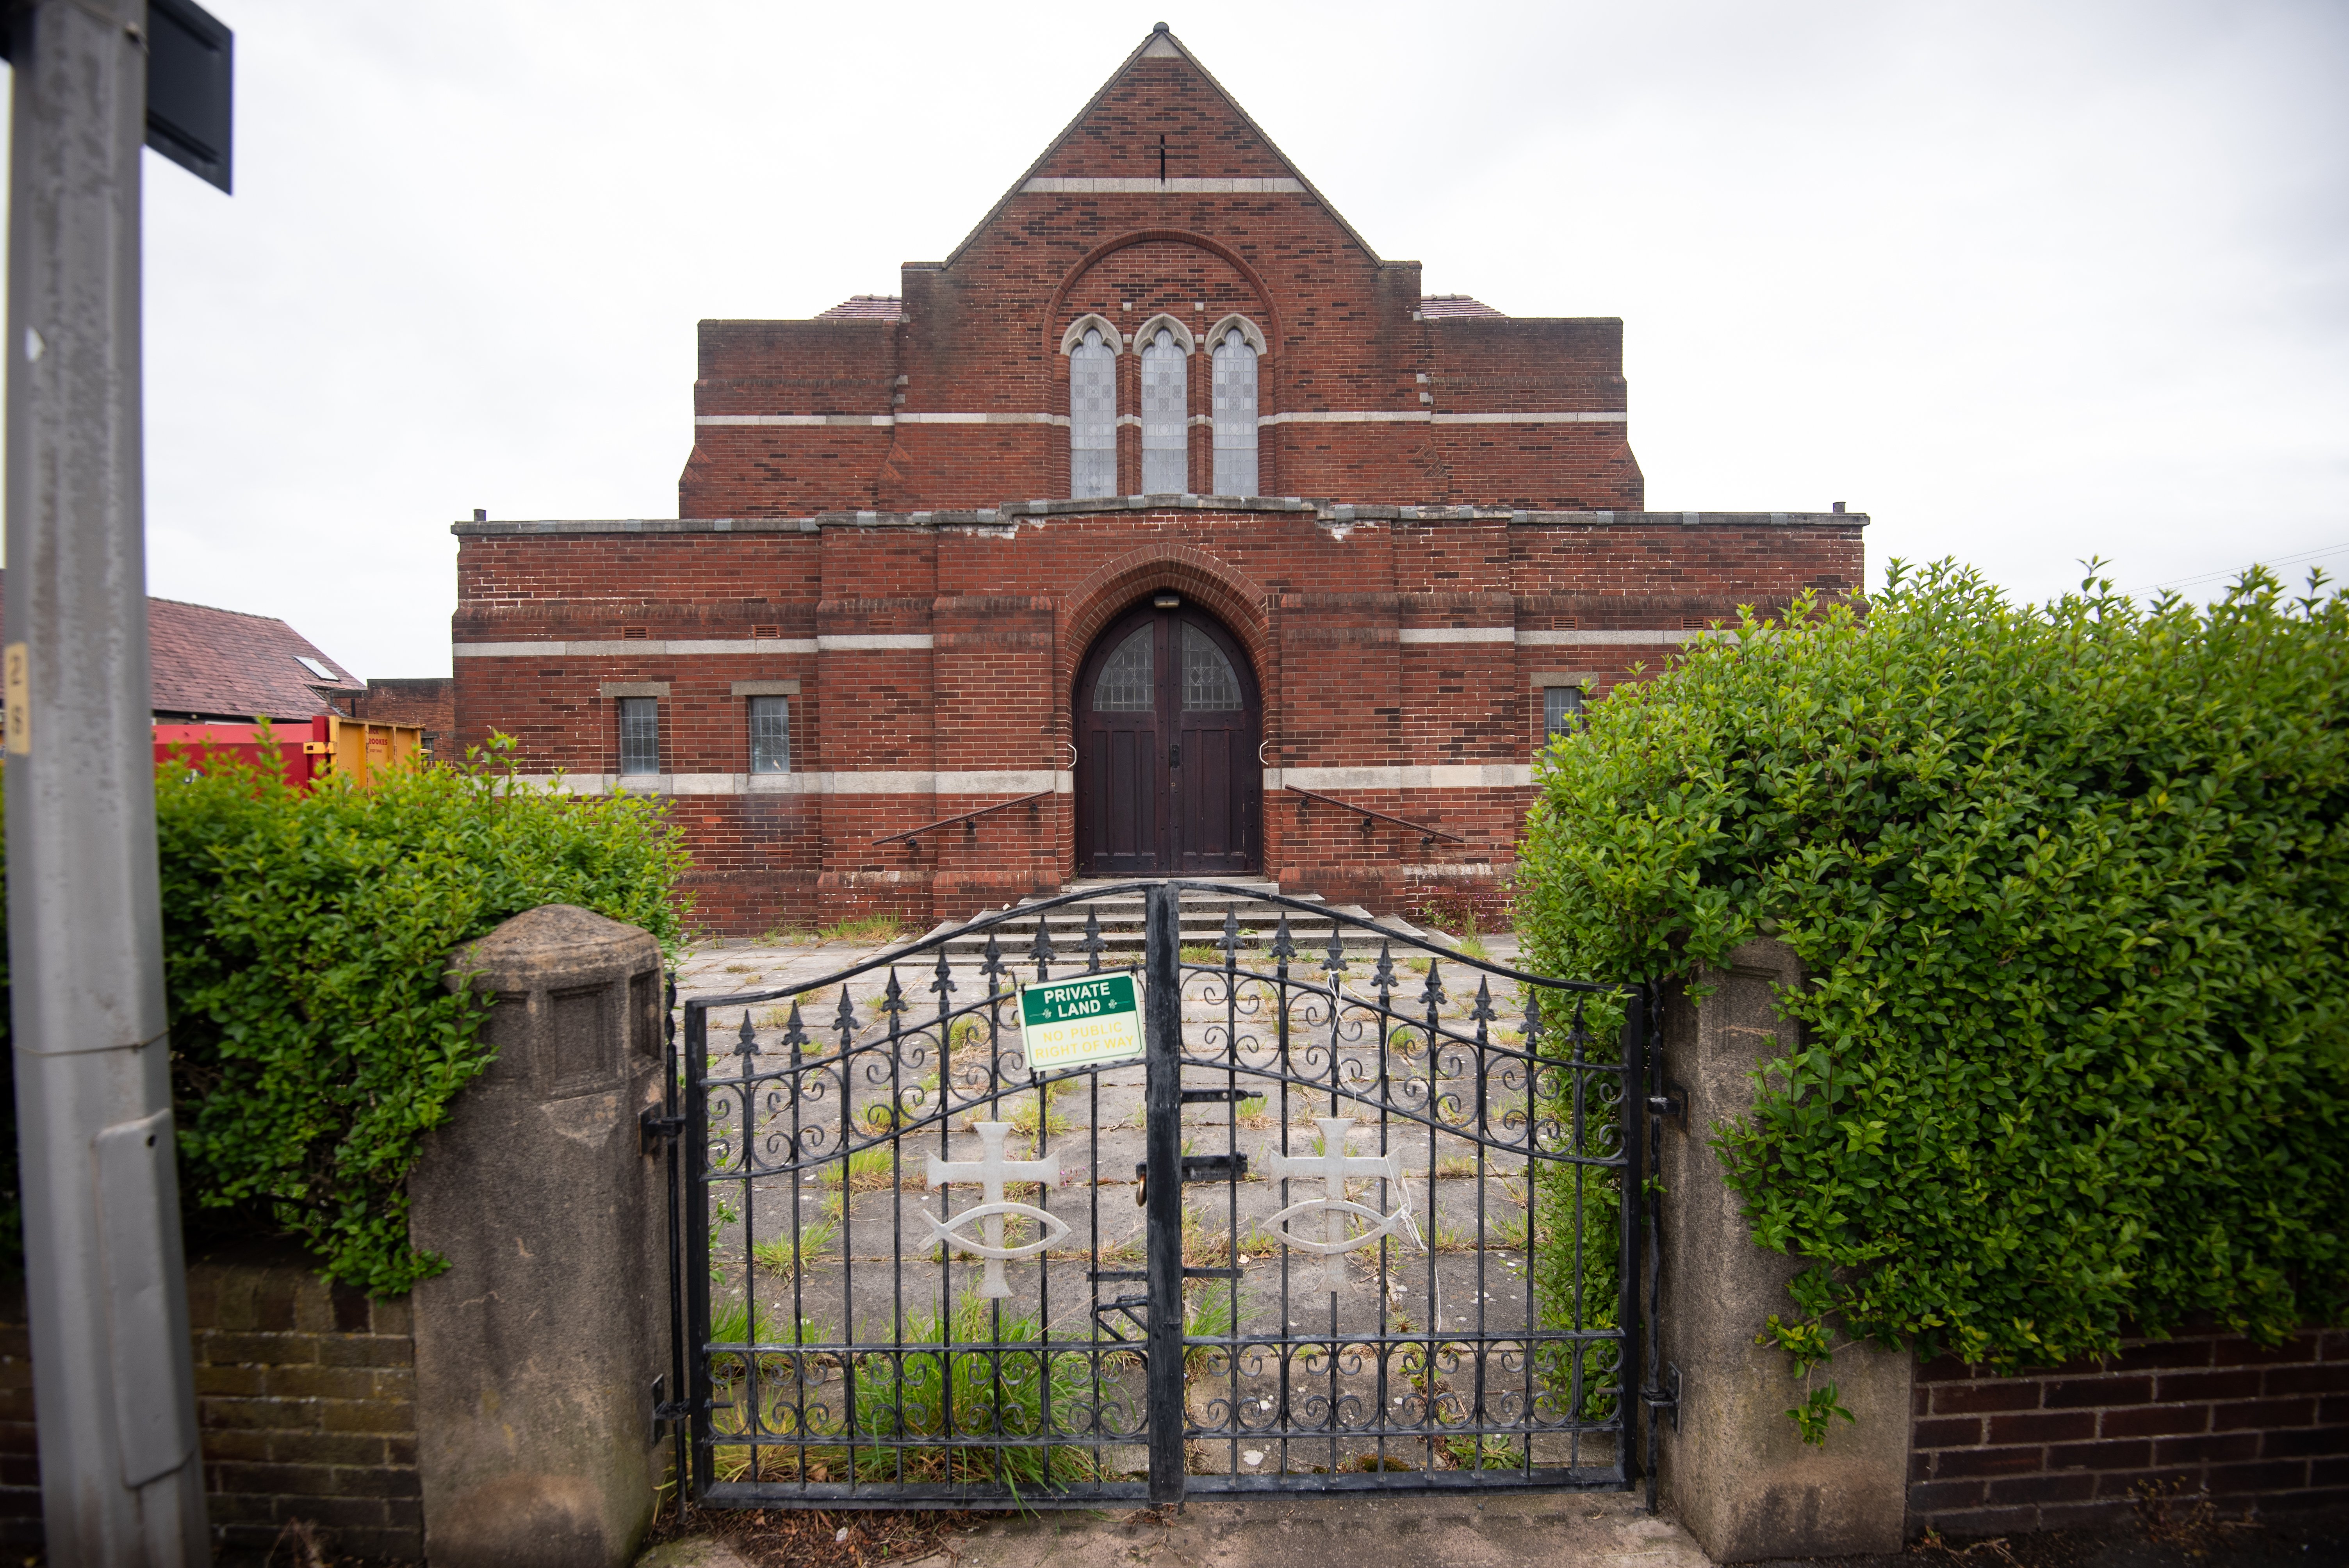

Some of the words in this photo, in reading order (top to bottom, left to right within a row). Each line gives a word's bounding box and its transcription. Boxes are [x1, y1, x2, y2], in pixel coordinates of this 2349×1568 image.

[1044, 982, 1110, 1004] PRIVATE
[1057, 1000, 1101, 1018] LAND
[1043, 1030, 1063, 1043] NO
[1070, 1022, 1122, 1039] PUBLIC
[1035, 1043, 1078, 1060] RIGHT
[1082, 1040, 1100, 1053] OF
[1104, 1035, 1134, 1049] WAY
